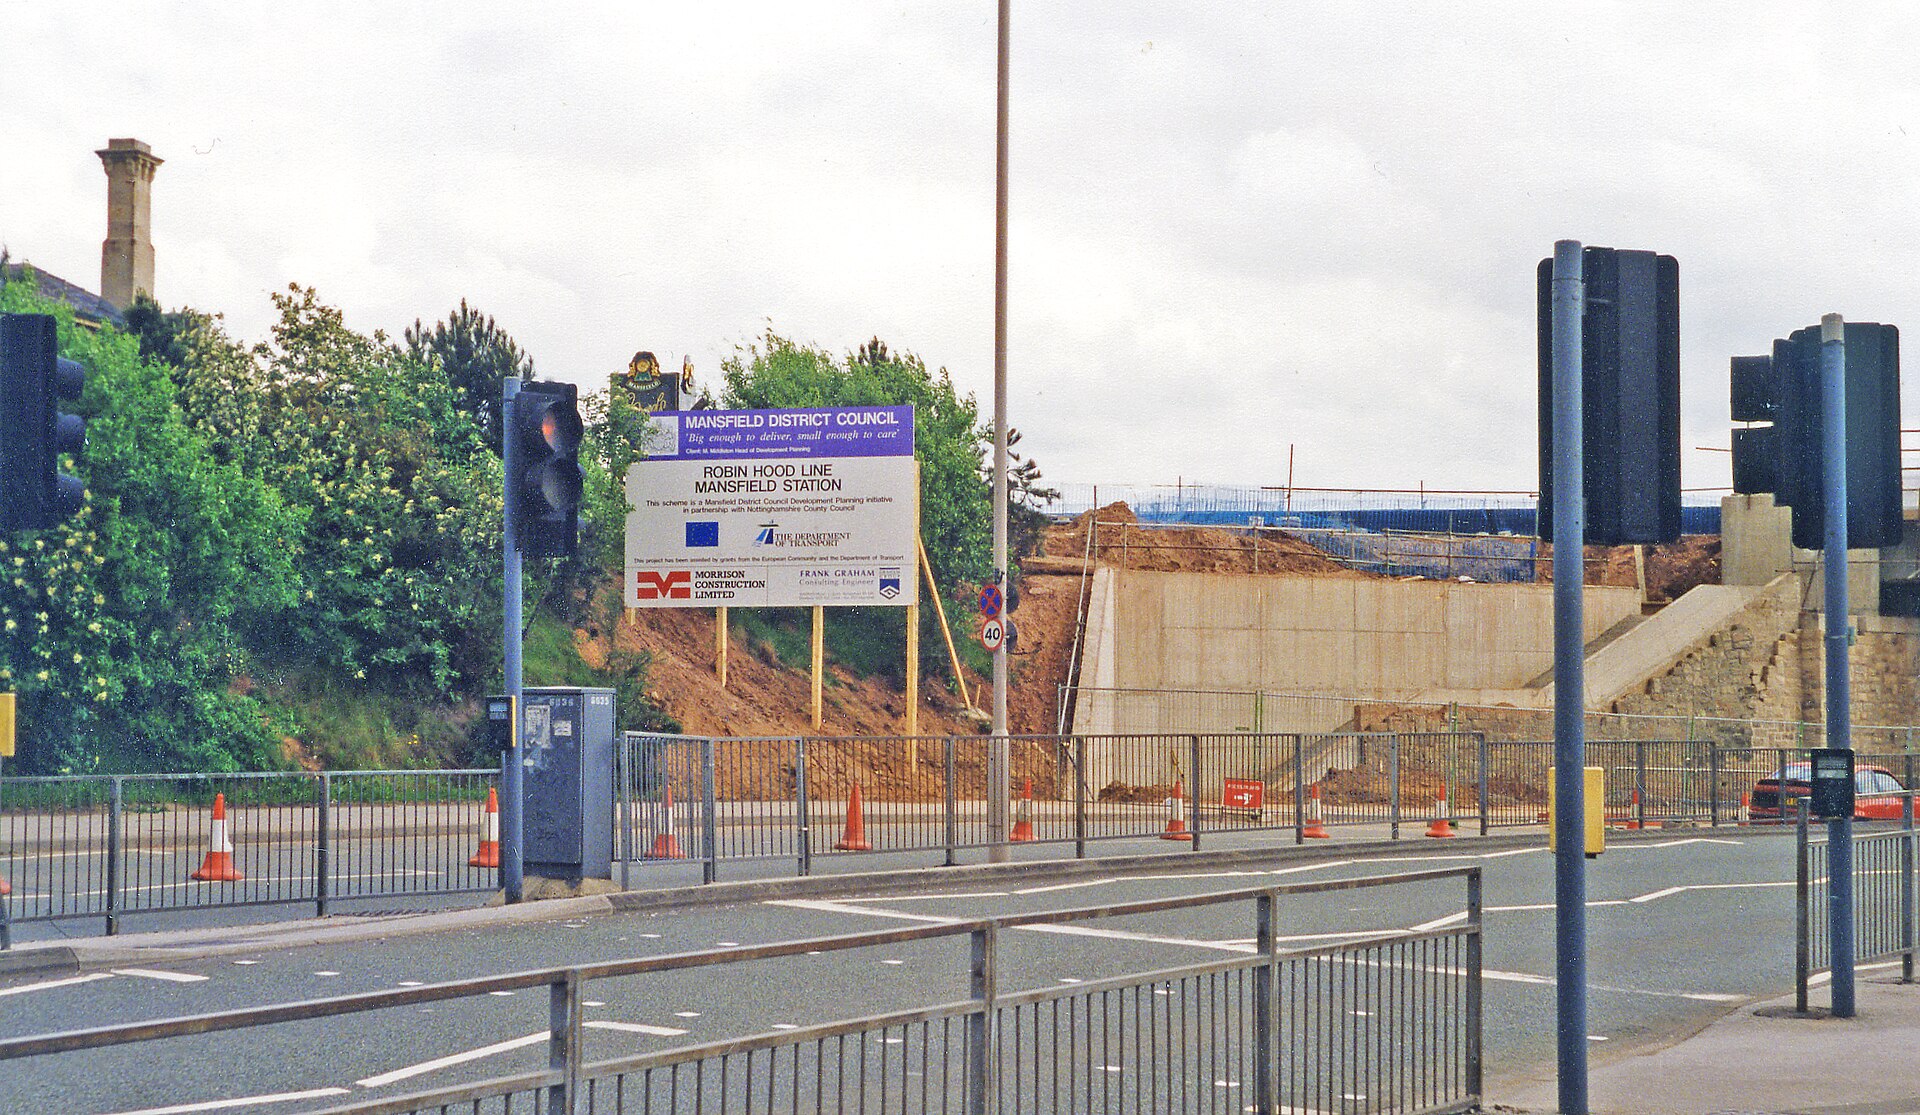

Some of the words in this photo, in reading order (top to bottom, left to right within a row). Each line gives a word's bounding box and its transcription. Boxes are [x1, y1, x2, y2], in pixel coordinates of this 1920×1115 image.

[685, 415, 764, 429] MANSFIELD
[768, 413, 832, 427] DISTRICT
[836, 411, 899, 425] COUNCIL
[708, 432, 741, 444] enough
[746, 433, 756, 441] to
[759, 431, 792, 442] deliver,
[796, 430, 821, 441] small
[825, 429, 859, 441] enough
[863, 430, 873, 439] to
[703, 465, 748, 479] ROBIN
[753, 464, 796, 478] HOOD
[801, 463, 833, 477] LINE
[694, 480, 777, 494] MANSFIELD
[783, 478, 842, 493] STATION
[662, 499, 688, 507] scheme
[704, 498, 736, 506] Mansfield
[738, 497, 761, 505] District
[763, 496, 788, 505] Council
[790, 497, 833, 505] Development
[835, 496, 864, 505] Planning
[690, 506, 728, 514] partnership
[746, 505, 801, 514] Nottinghamshire
[803, 504, 827, 513] County
[829, 504, 855, 512] Council
[775, 533, 793, 541] THE
[795, 532, 851, 540] DEPARTMENT
[790, 539, 839, 547] TRANSPORT
[695, 571, 745, 579] MORRISON
[834, 569, 875, 577] GRAHAM
[694, 580, 766, 589] CONSTRUCTION
[695, 590, 735, 599] LIMITED
[985, 627, 1000, 641] 40
